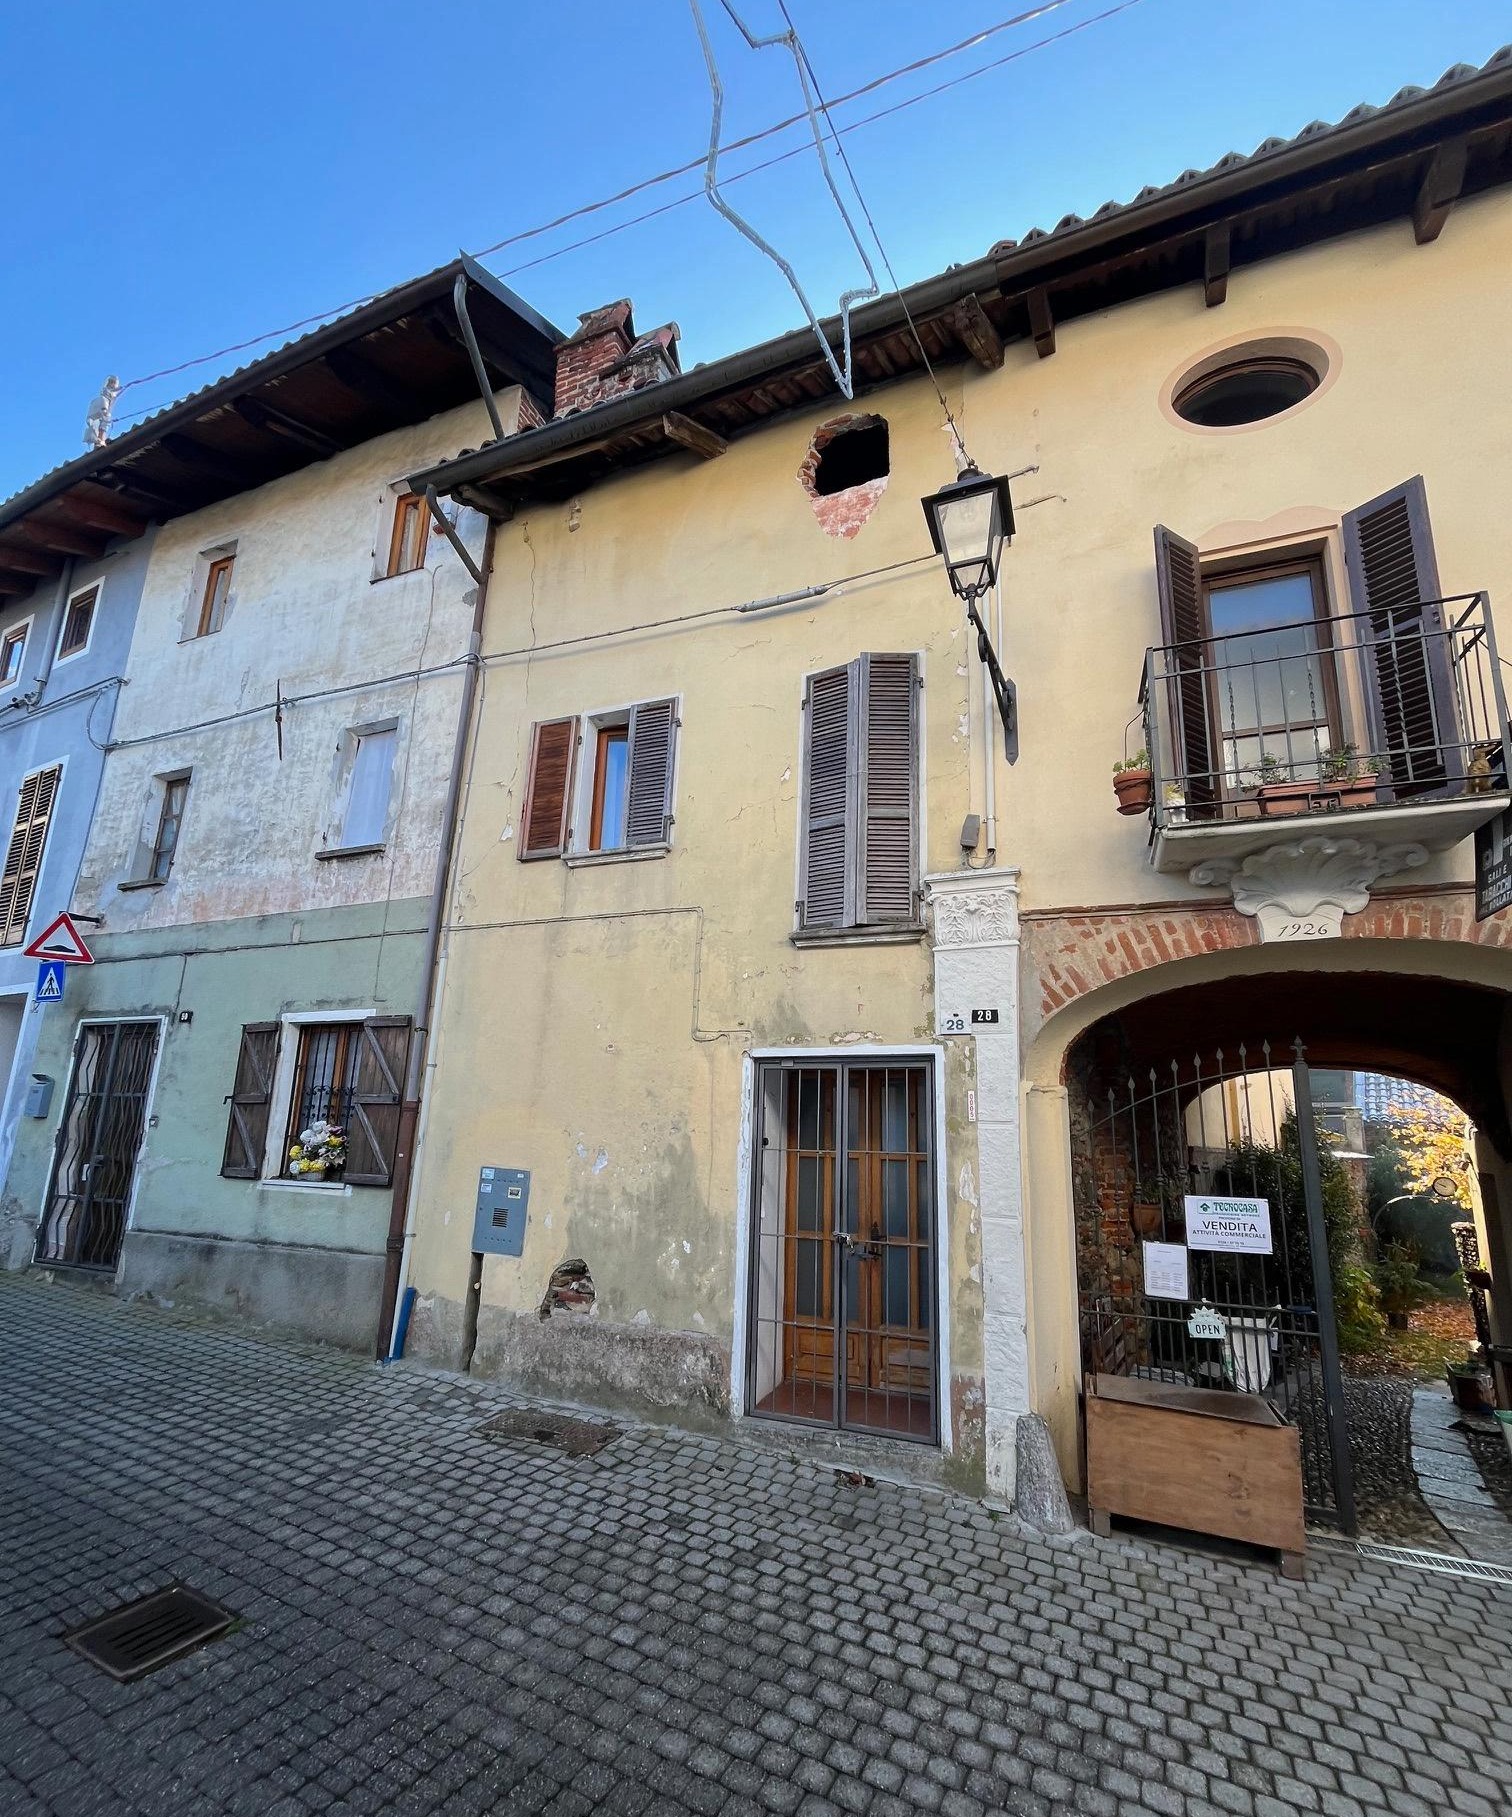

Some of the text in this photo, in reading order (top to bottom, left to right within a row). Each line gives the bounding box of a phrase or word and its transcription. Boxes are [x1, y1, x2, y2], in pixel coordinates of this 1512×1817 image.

[1278, 923, 1329, 937] 1926
[977, 1010, 992, 1021] 28
[946, 1019, 965, 1031] 28
[1213, 1202, 1258, 1213] TECNOCASA
[1202, 1221, 1257, 1232] VENDITA
[1220, 1231, 1266, 1239] COMMERCIALE
[1195, 1325, 1220, 1334] OPEN
